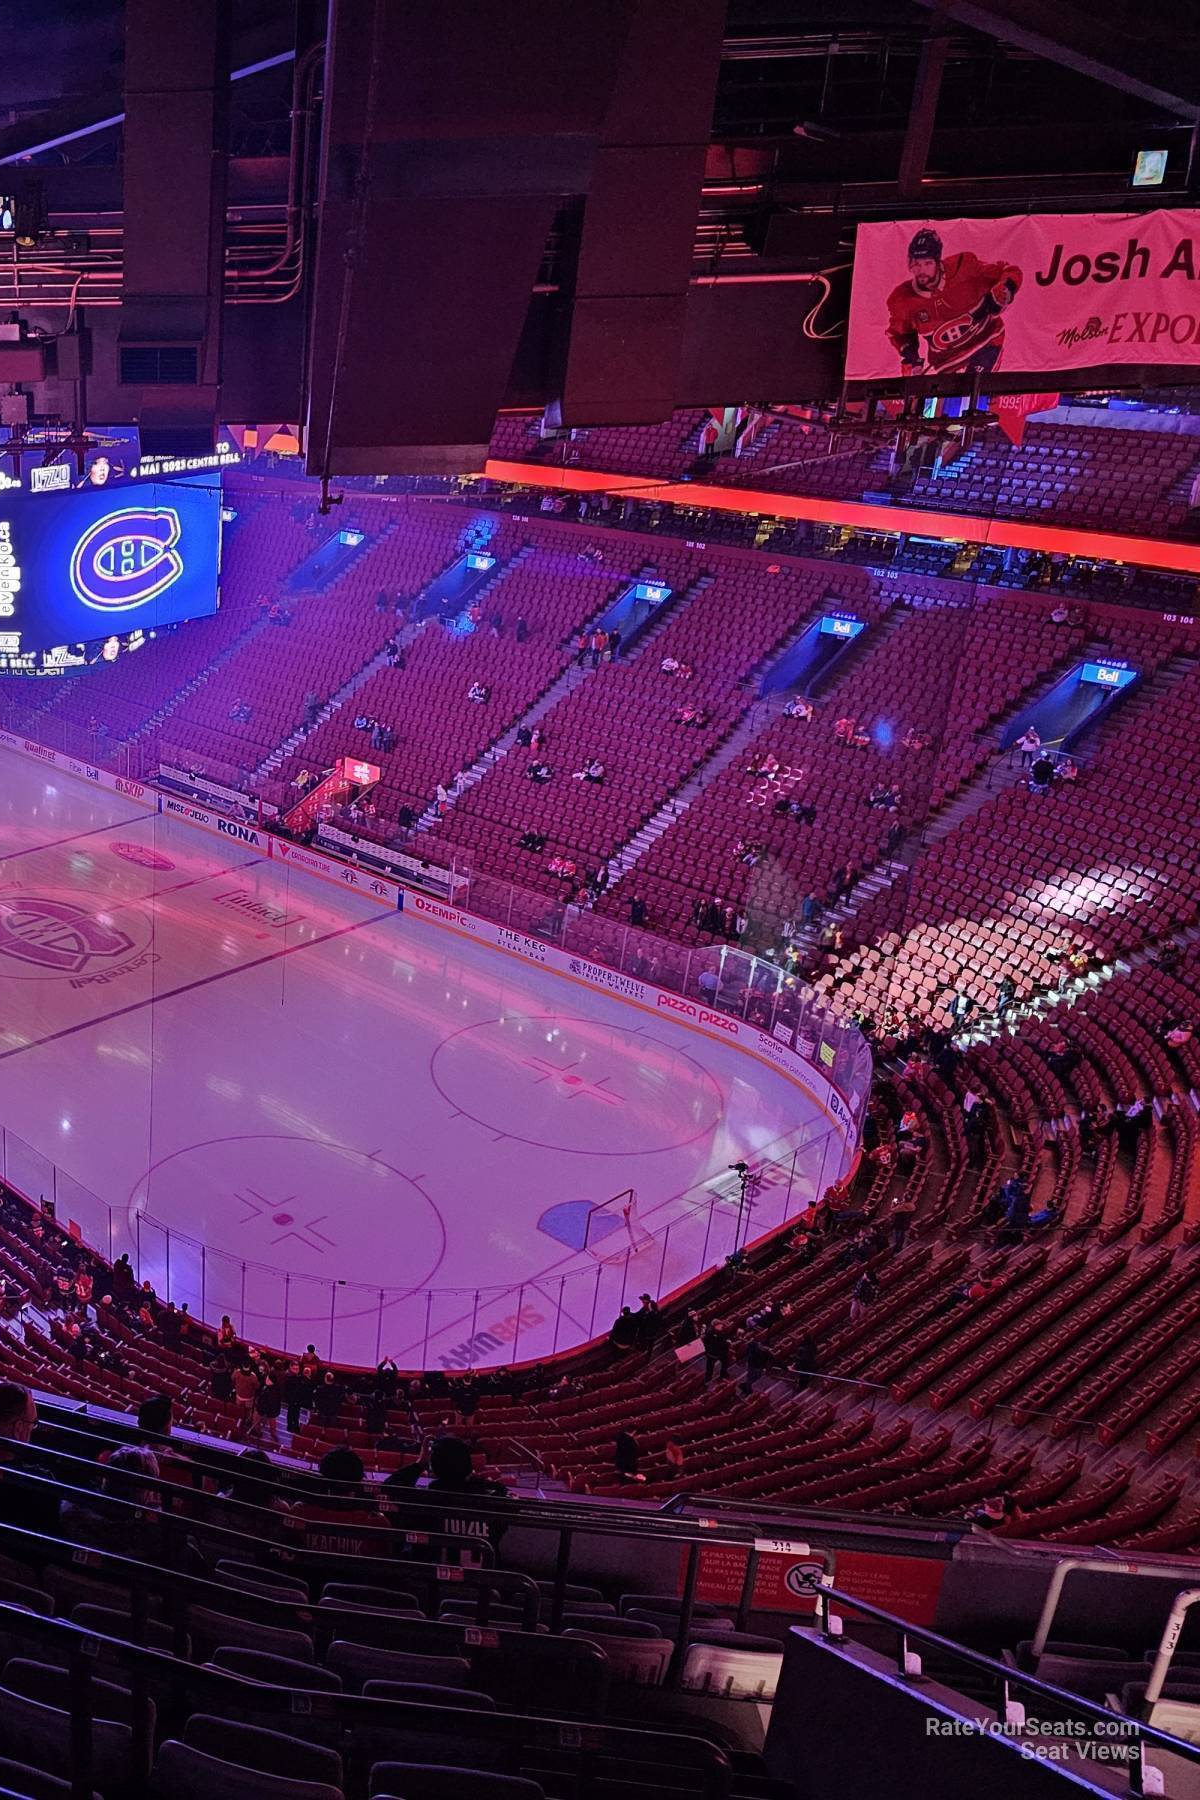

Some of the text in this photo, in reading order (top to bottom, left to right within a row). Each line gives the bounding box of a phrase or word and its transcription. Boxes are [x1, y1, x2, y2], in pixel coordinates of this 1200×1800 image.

[1035, 238, 1200, 286] Josh A
[1056, 321, 1109, 349] Molson
[140, 463, 160, 476] MAI
[163, 460, 187, 473] 2023
[187, 456, 219, 470] CENTRE
[220, 453, 240, 465] BELL
[874, 569, 898, 579] 102 103
[833, 621, 851, 633] Bell
[1163, 613, 1194, 624] 103 104
[1097, 668, 1119, 682] Bell
[86, 766, 99, 781] Bell
[124, 781, 144, 798] SKIP
[217, 819, 260, 846] RONA
[498, 928, 546, 952] THE KEG
[69, 953, 161, 989] CentreBell
[583, 963, 645, 994] PROPER TWELVE
[657, 994, 739, 1035] pizza pizza
[759, 1034, 783, 1053] Scotia
[438, 1304, 544, 1369] SUBWAY
[772, 1541, 792, 1552] 314
[1167, 1623, 1180, 1650] 313
